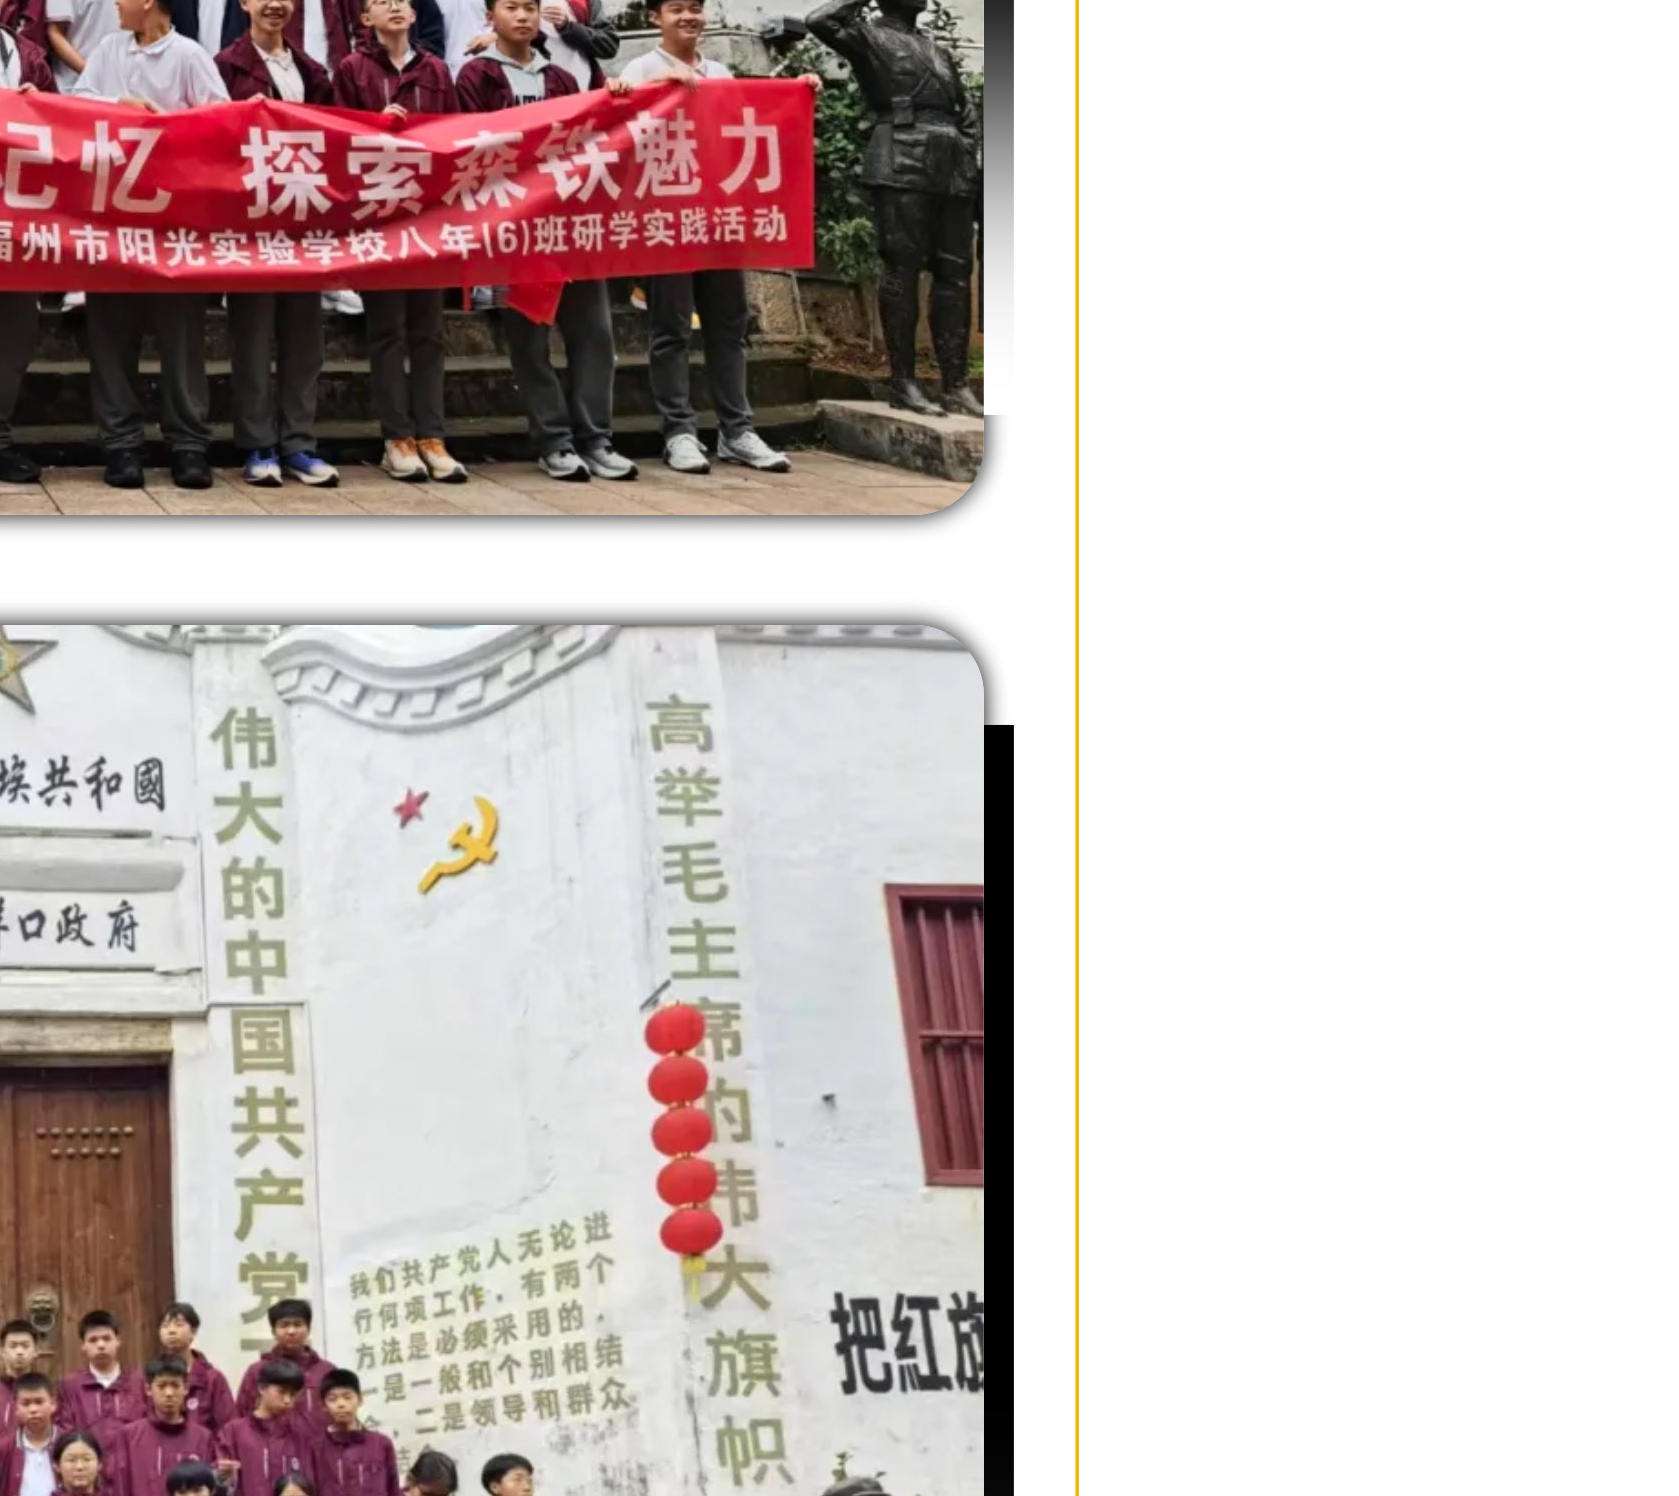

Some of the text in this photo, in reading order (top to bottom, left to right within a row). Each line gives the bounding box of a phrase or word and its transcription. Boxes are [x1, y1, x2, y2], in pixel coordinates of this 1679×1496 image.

[243, 104, 784, 222] 探索森铁魅力
[210, 707, 309, 1356] 伟大的中国共产党
[349, 1210, 613, 1301] 我们共产党人无论进
[361, 1334, 624, 1403] 一是一般和个别相结
